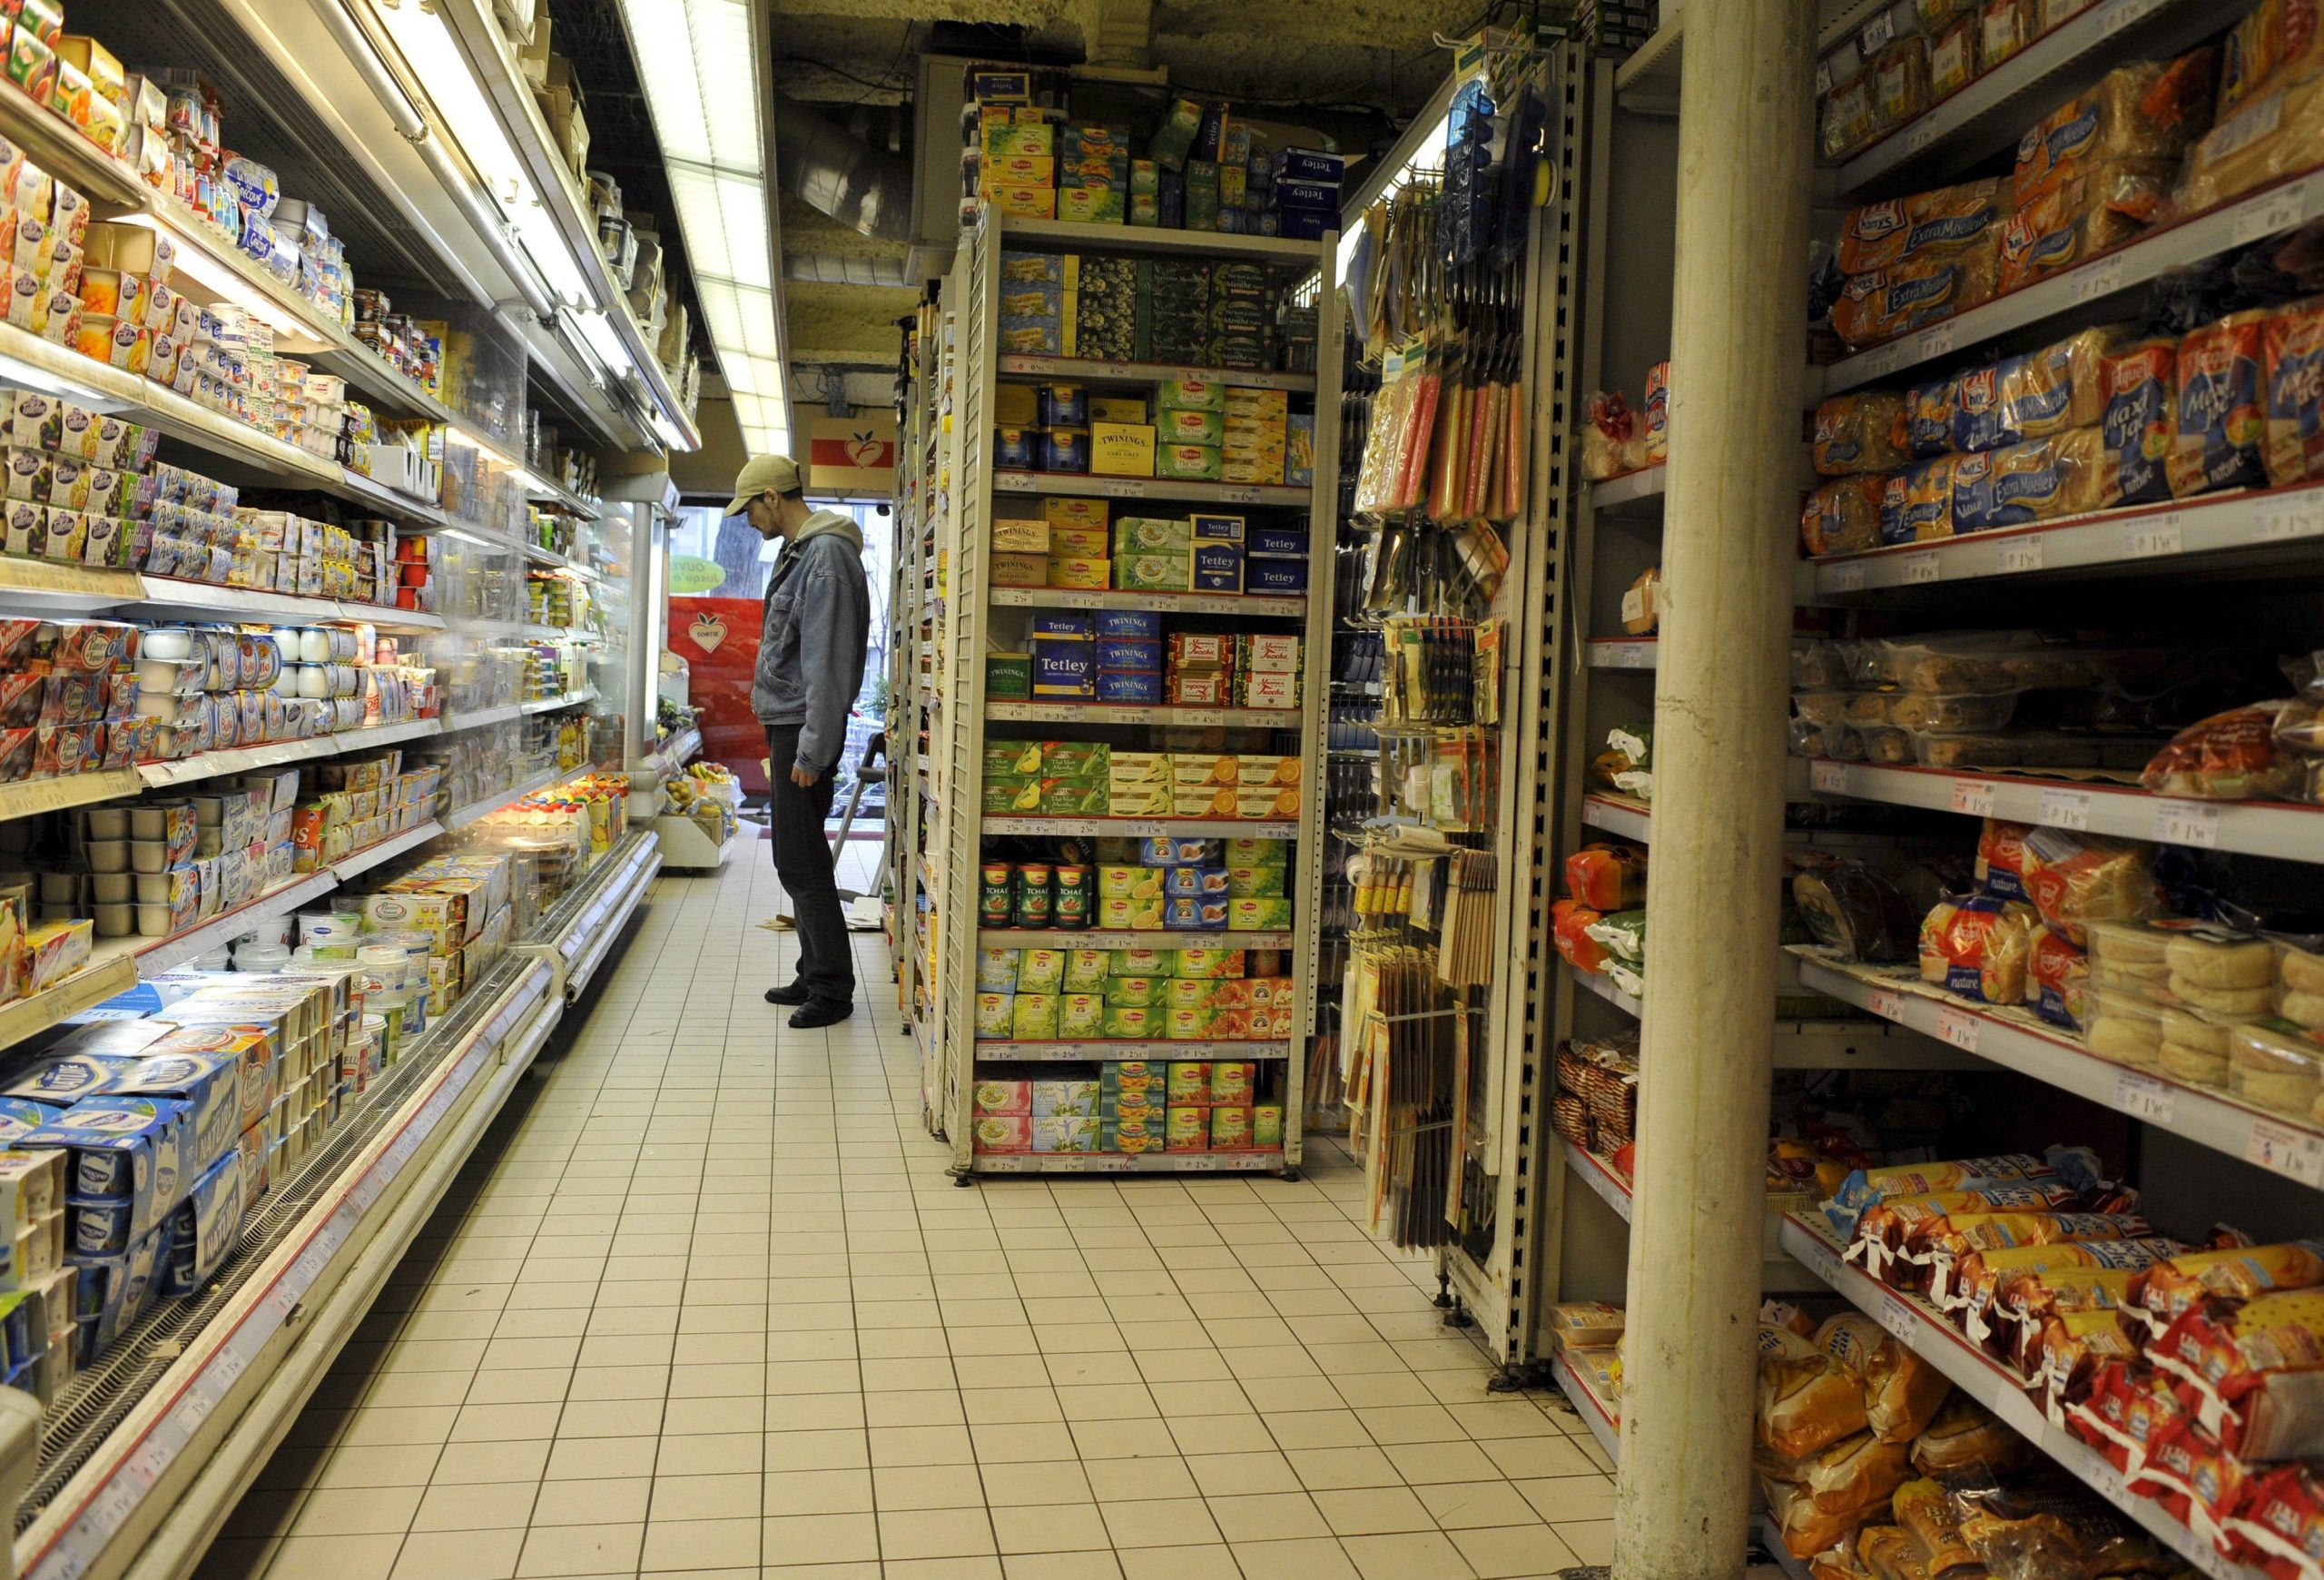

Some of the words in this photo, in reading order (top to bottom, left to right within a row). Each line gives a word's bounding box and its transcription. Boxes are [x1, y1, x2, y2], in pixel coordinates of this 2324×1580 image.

[1207, 118, 1219, 147] Tetley
[1301, 158, 1333, 173] Tetley
[1291, 187, 1324, 201] Tetley
[1909, 227, 1941, 249] Extra
[1940, 212, 1990, 238] Moelleux
[1892, 285, 1920, 310] Extra
[1222, 353, 1247, 361] Menthe
[1182, 383, 1205, 392] Lipton
[2104, 390, 2148, 435] Maxi
[1180, 417, 1203, 426] Lipton
[1100, 434, 1147, 448] TWININGS
[1179, 450, 1201, 459] Lipton
[2210, 452, 2244, 484] nature
[2124, 468, 2154, 496] nature
[127, 483, 153, 503] Bifidus
[1995, 479, 2021, 503] Extra
[1207, 523, 1229, 532] Tetley
[125, 532, 149, 548] Bifidus
[1264, 538, 1296, 550] Tetley
[1200, 555, 1236, 567] Tetley
[1263, 572, 1295, 584] Tetley
[1049, 621, 1077, 632] Tetley
[1107, 617, 1148, 628] TWININGS
[1108, 648, 1148, 659] TWININGS
[990, 668, 1025, 677] TWININGS
[1040, 657, 1089, 674] Tetley
[1108, 680, 1148, 691] TWININGS
[1990, 876, 2019, 894] nature
[1951, 976, 1979, 992] nature
[2043, 998, 2065, 1015] nature
[200, 1097, 234, 1162] NATURE
[81, 1165, 109, 1182] DANONE
[206, 1190, 240, 1259] NATURE
